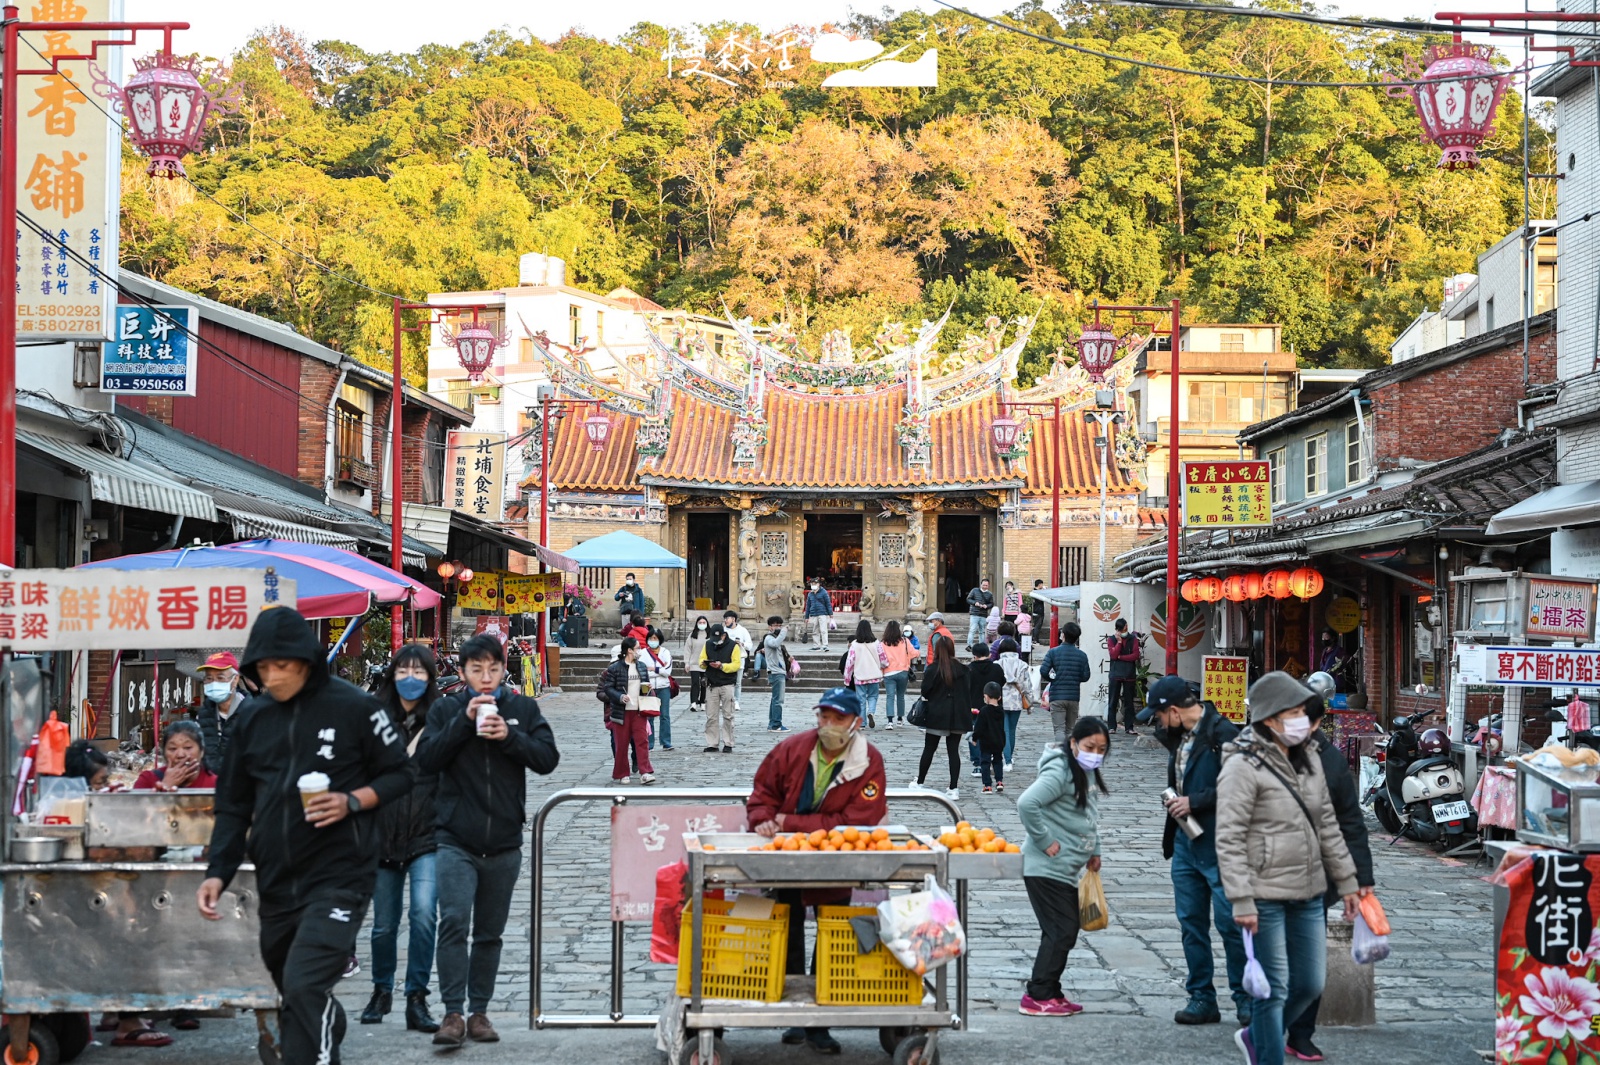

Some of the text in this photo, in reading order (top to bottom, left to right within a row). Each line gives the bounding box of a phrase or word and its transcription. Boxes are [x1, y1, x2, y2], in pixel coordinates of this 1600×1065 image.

[117, 343, 174, 360] 科技社
[473, 438, 493, 514] 北埔食堂
[1238, 485, 1251, 522] 有機蔬菜
[1254, 485, 1266, 521] 客家小吃
[58, 586, 248, 631] 鮮嫩香腸
[1543, 605, 1586, 629] 擂茶
[1206, 687, 1243, 697] 客家小吃
